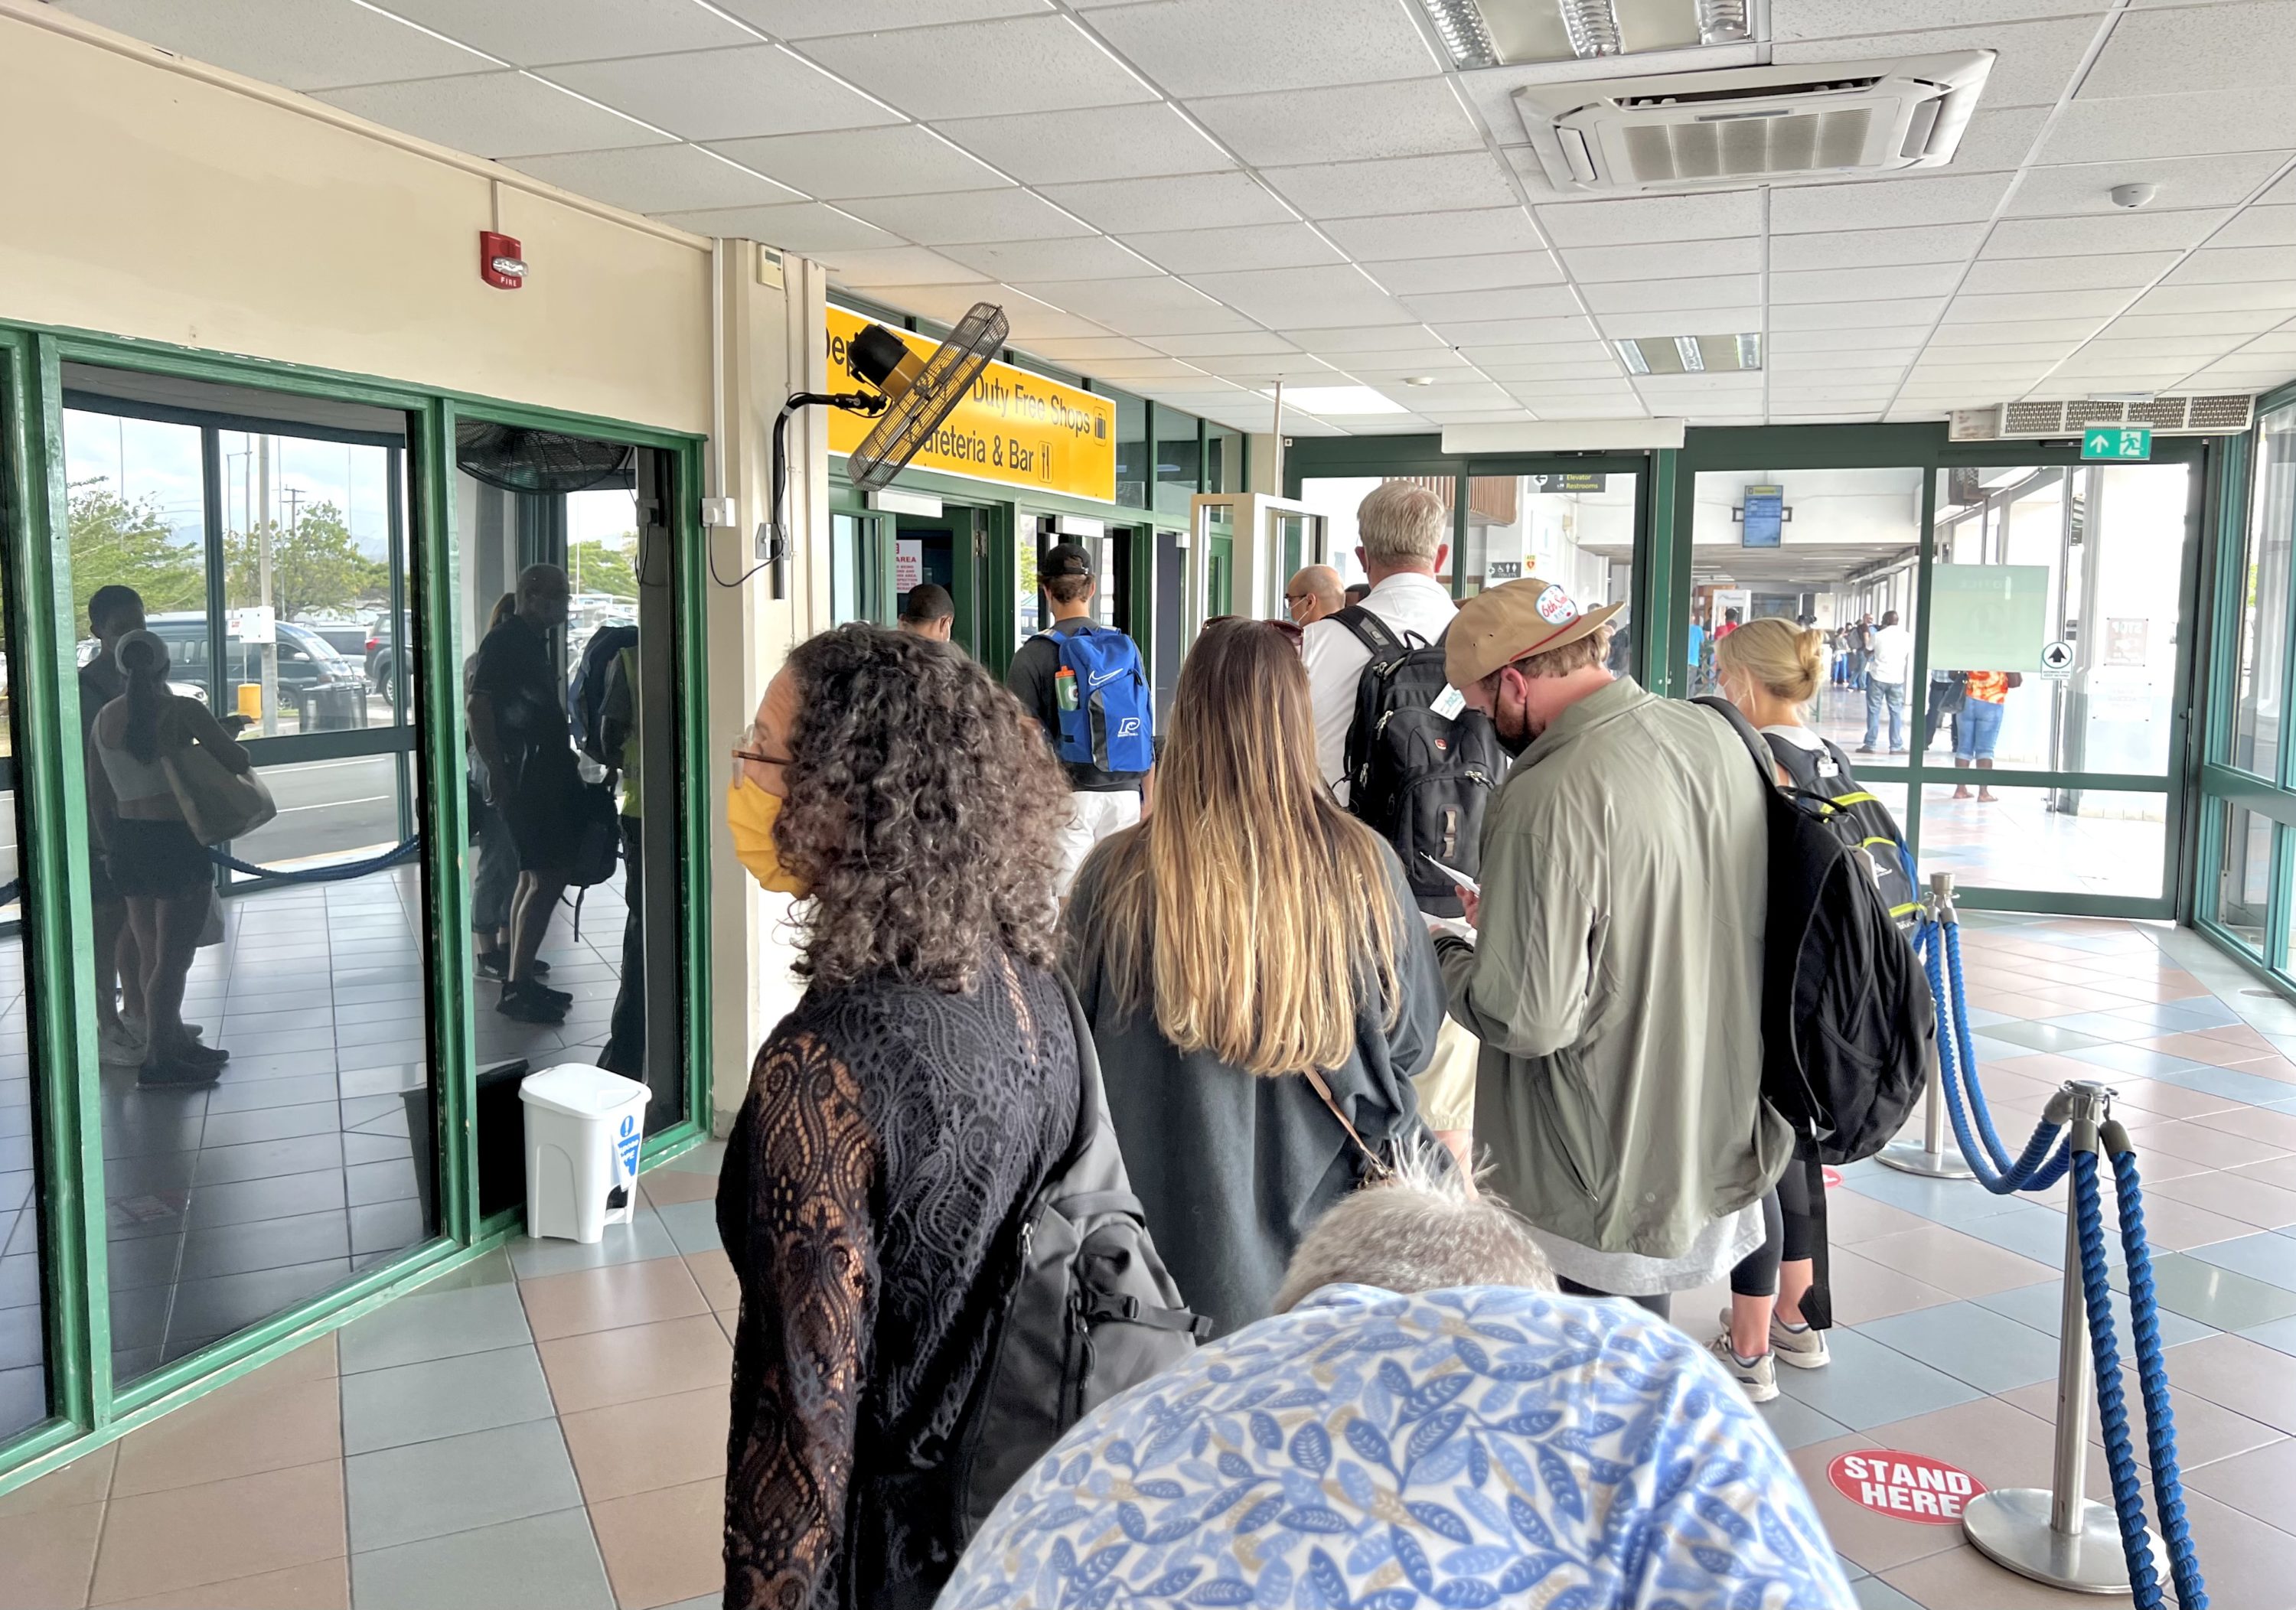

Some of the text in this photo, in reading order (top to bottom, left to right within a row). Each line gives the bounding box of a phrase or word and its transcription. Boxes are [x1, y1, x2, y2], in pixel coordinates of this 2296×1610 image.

[501, 276, 517, 287] FIRE
[974, 373, 1090, 438] Duty Free Shops
[922, 425, 1034, 472] afeteria & Bar
[1844, 1455, 1972, 1495] STAND
[1861, 1481, 1963, 1519] HERE
